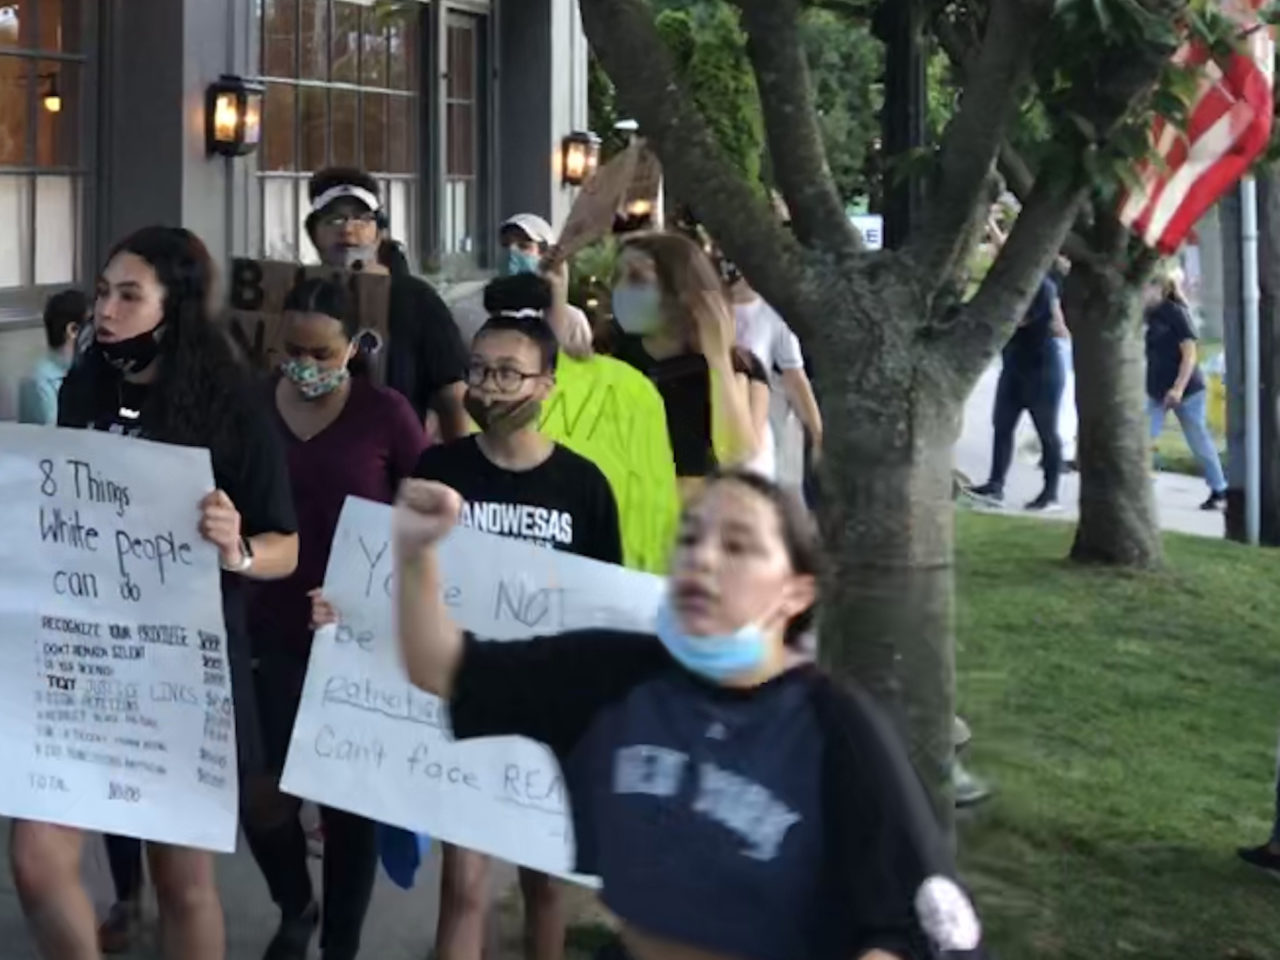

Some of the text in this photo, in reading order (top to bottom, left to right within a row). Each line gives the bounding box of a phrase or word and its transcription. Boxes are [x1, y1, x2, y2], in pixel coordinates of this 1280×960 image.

[39, 459, 131, 518] 8 Things
[39, 504, 193, 585] White people
[53, 570, 141, 602] can do
[494, 579, 567, 627] NOT
[333, 626, 376, 653] be
[407, 743, 483, 791] face
[503, 763, 566, 804] REA
